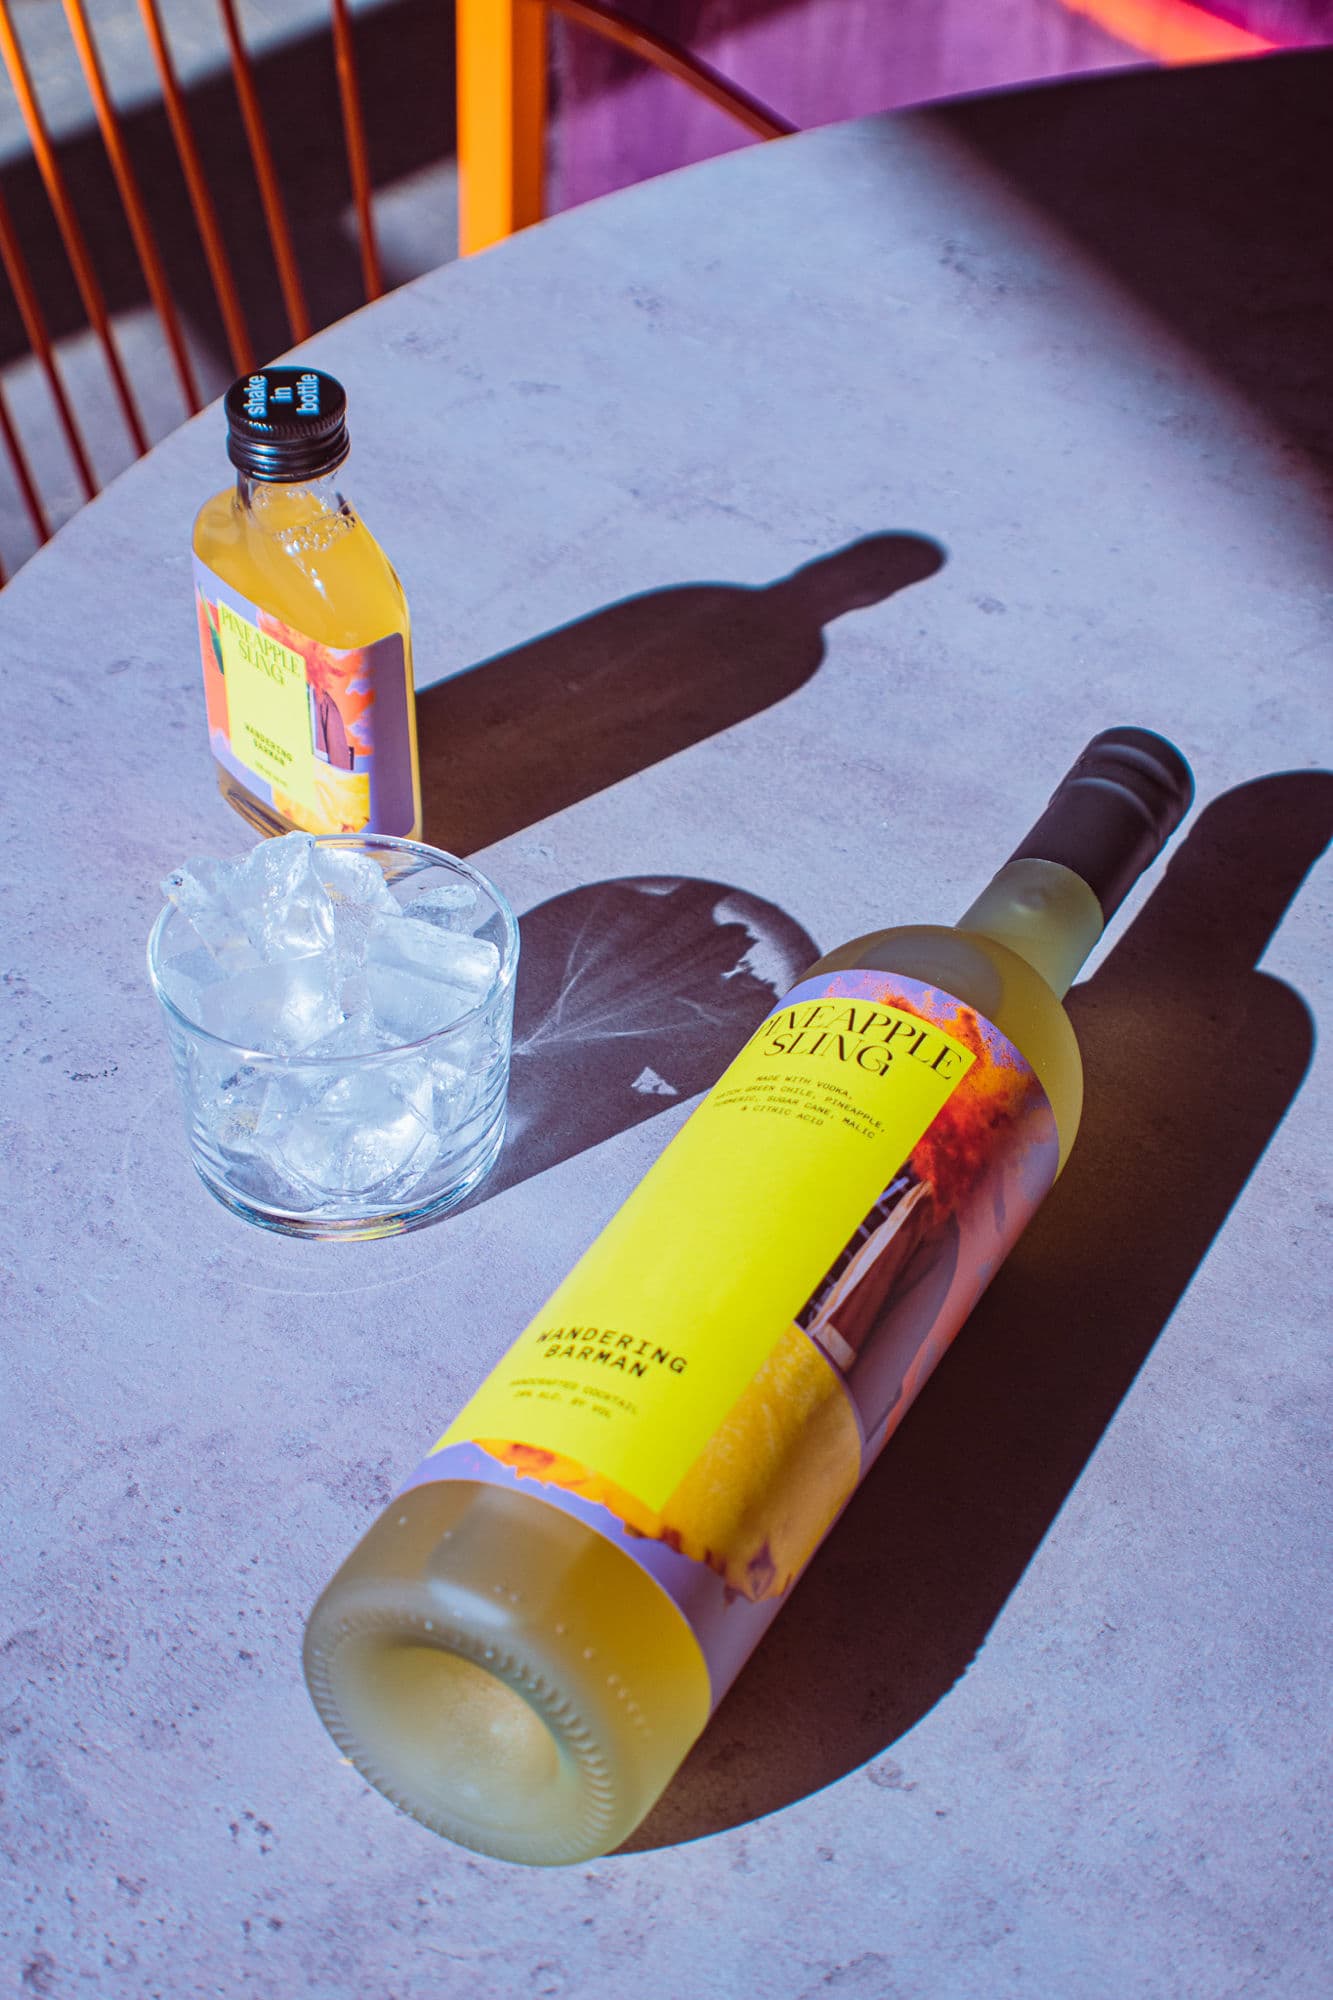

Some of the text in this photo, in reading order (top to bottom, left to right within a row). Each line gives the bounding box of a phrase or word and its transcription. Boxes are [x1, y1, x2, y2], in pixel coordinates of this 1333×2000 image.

[243, 375, 267, 418] shake
[270, 386, 292, 404] in
[296, 374, 319, 415] bottle
[221, 604, 300, 679] PINEAPPLE
[239, 640, 285, 686] SLING
[748, 1004, 962, 1080] PINEAPPLE
[764, 1032, 893, 1077] SLING
[780, 1085, 816, 1100] CHILE,
[825, 1096, 886, 1133] PINEAPPLE,
[784, 1075, 812, 1085] WITH
[817, 1082, 852, 1100] VODKA,
[753, 1105, 792, 1116] CITRIC
[797, 1113, 825, 1127] ACID
[767, 1095, 799, 1106] SUGAR
[804, 1102, 834, 1119] CANE,
[842, 1117, 875, 1139] MALIC
[536, 1327, 688, 1374] WANDERING
[544, 1343, 648, 1378] BARMAN
